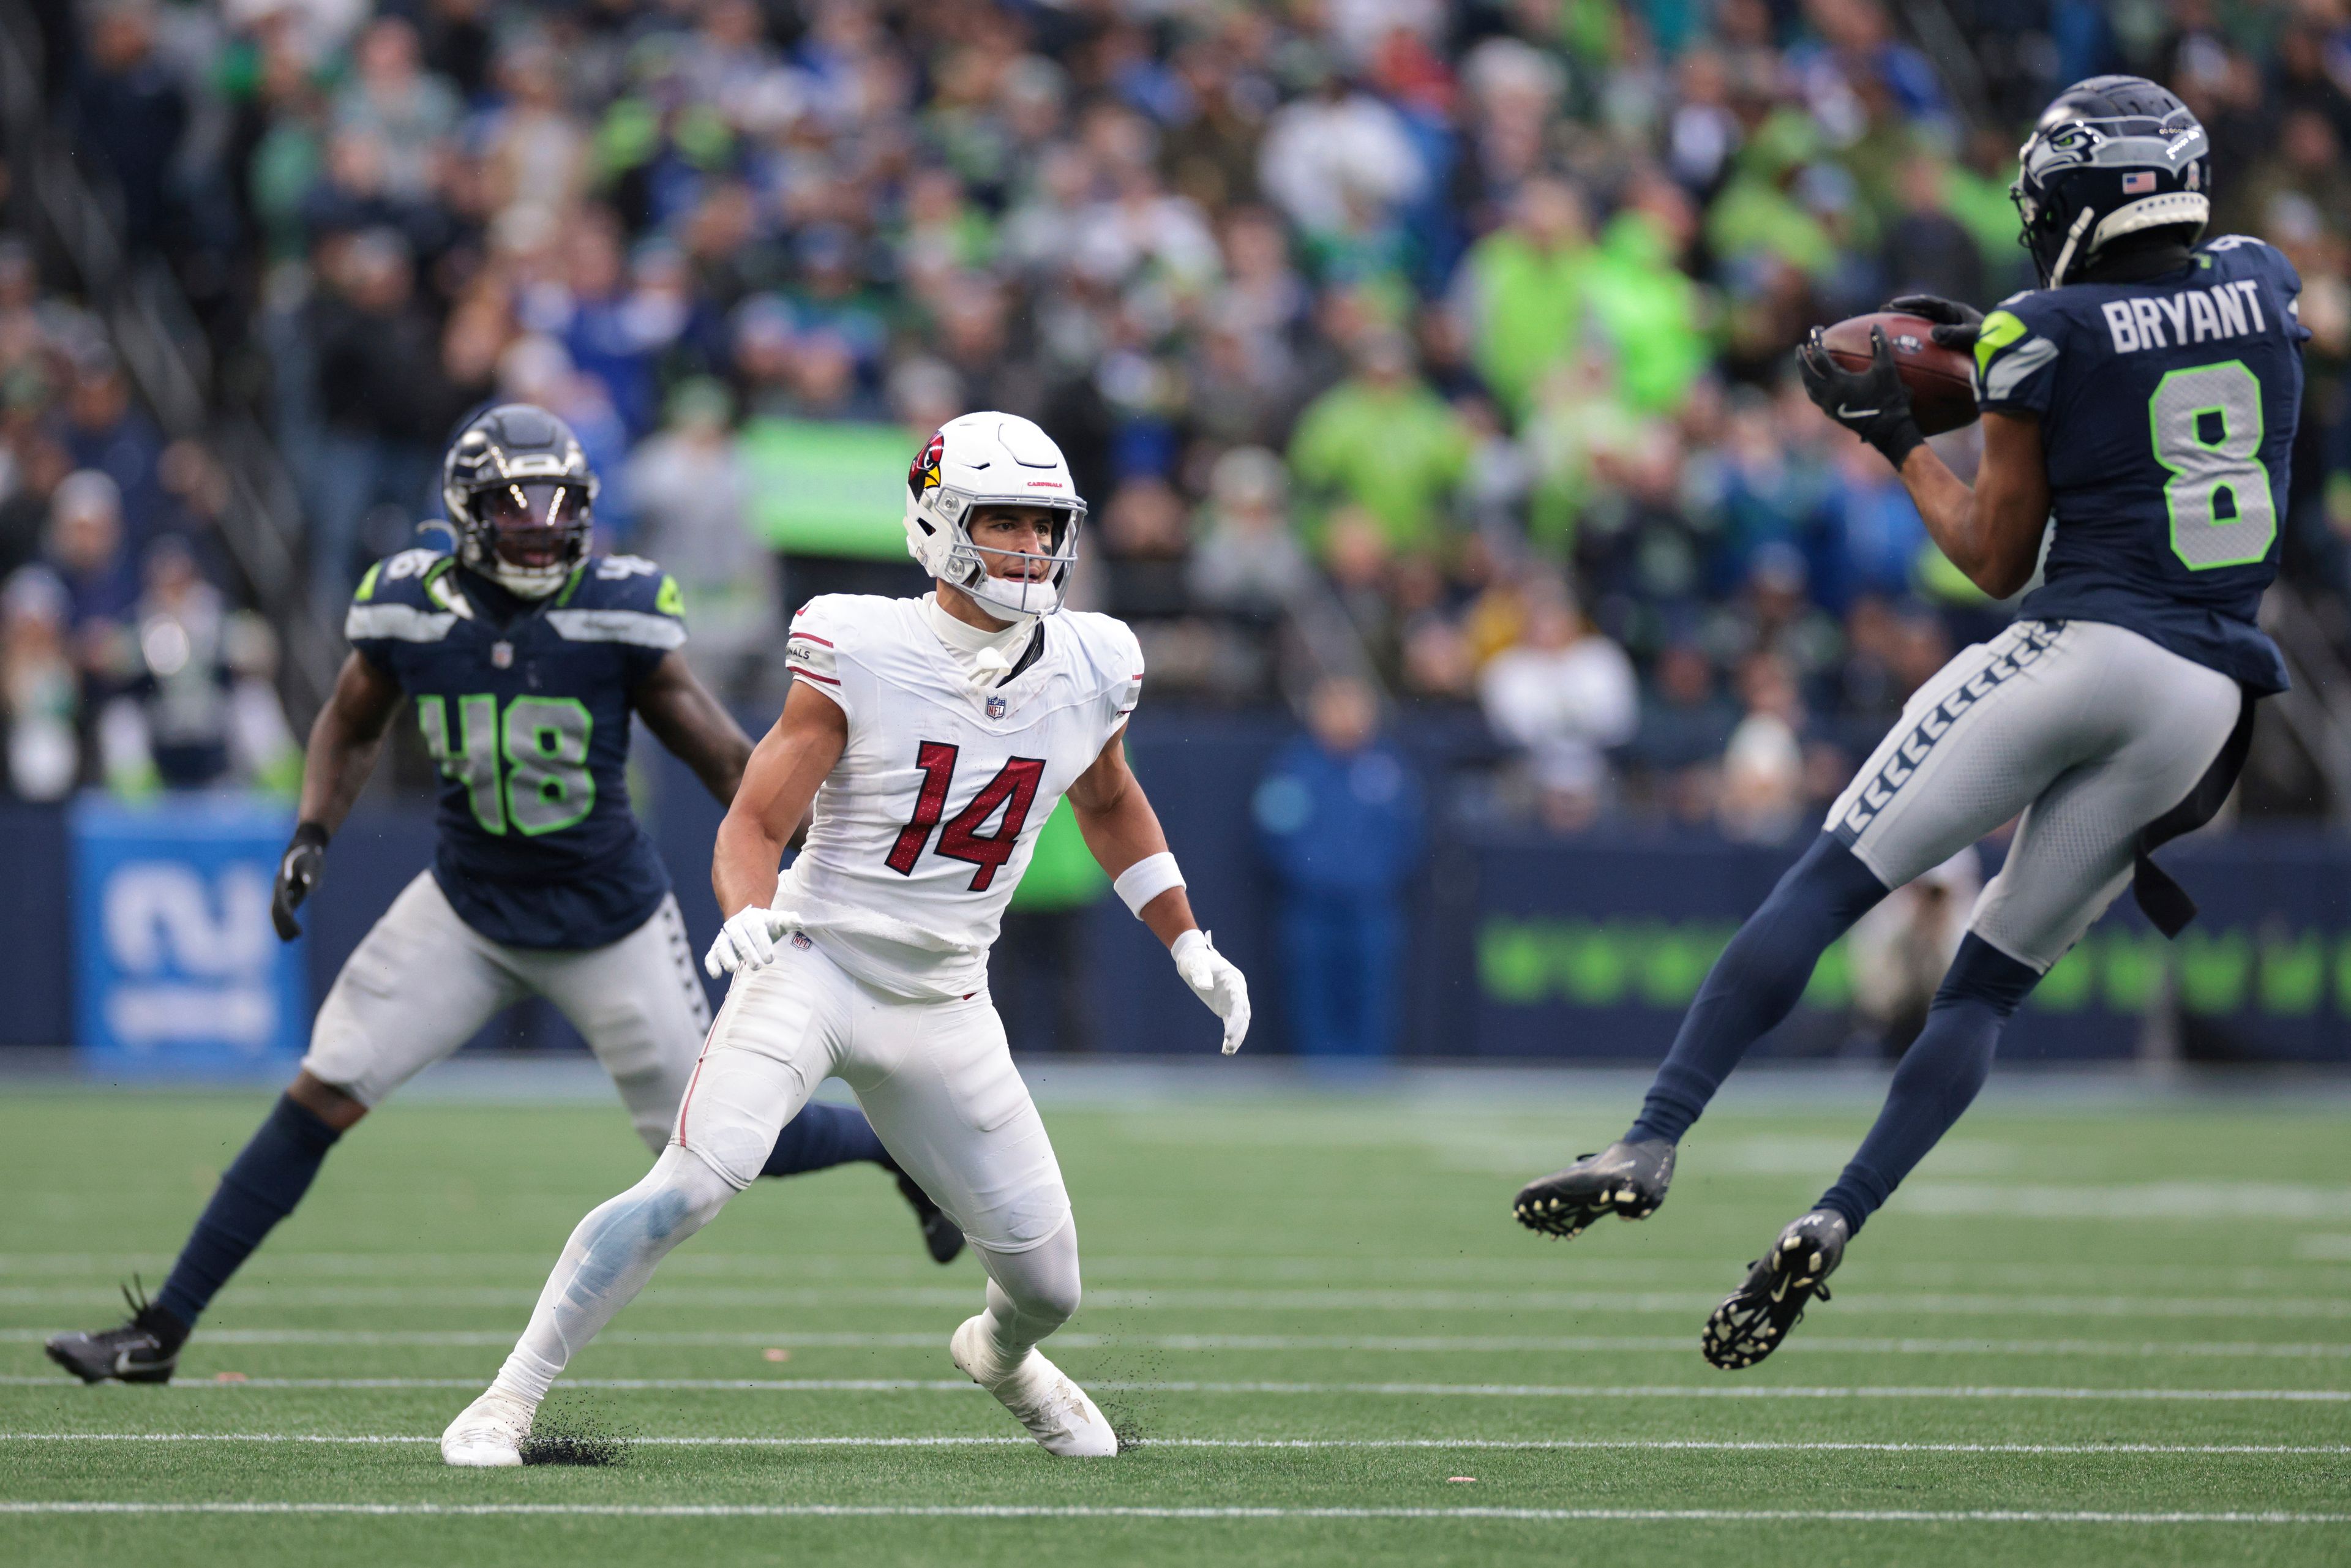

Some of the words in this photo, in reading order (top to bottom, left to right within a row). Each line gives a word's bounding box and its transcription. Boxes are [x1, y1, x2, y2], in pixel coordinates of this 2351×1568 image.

[2101, 280, 2266, 354] BRYANT
[2148, 359, 2277, 571] 8
[416, 692, 596, 836] 48
[989, 705, 1003, 716] NFL
[884, 740, 1047, 892] 14
[794, 937, 808, 948] NFL
